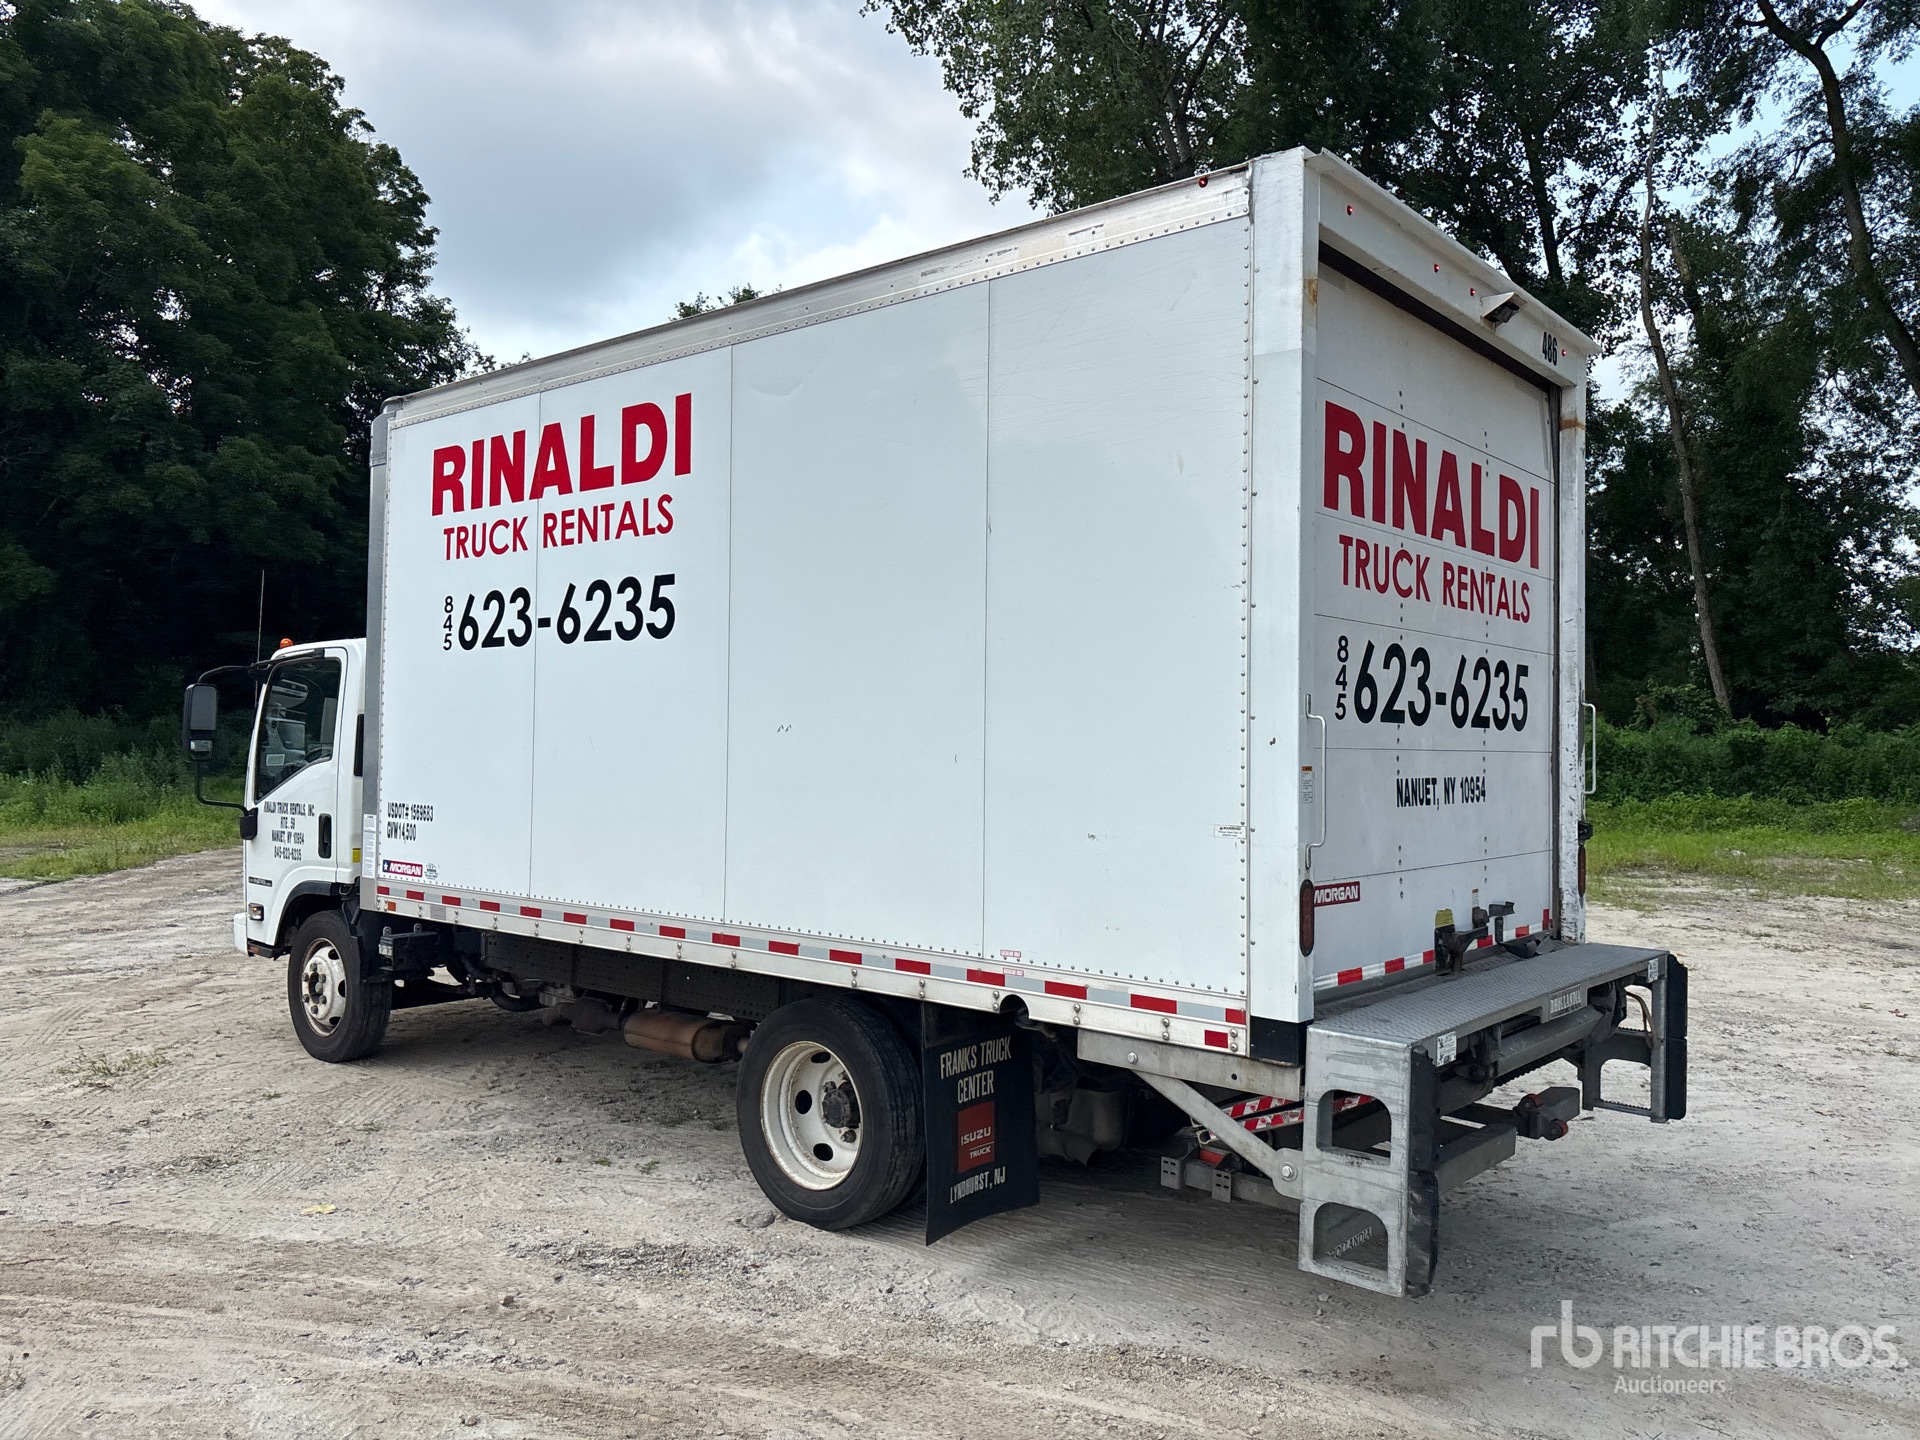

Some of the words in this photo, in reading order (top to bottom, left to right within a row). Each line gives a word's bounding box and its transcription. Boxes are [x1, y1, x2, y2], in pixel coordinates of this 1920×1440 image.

[1542, 331, 1557, 366] 486
[432, 392, 692, 516] RINALDI
[1323, 400, 1540, 570] RINALDI
[443, 516, 529, 561] TRUCK
[542, 494, 674, 548] RENTALS
[1338, 534, 1431, 602] TRUCK
[1443, 561, 1531, 624] RENTALS
[458, 573, 676, 651] 623-6235
[1354, 639, 1530, 732] 623-6235
[1396, 777, 1440, 811] NANUET,
[1444, 776, 1456, 805] NY
[1460, 776, 1486, 804] 10954
[389, 862, 422, 876] MORGAN
[1313, 885, 1359, 904] MORGAN
[940, 1044, 978, 1079] FRANKS
[980, 1036, 1011, 1066] TRUCK
[957, 1069, 994, 1104] CENTER
[960, 1126, 992, 1146] ISUZU
[969, 1146, 992, 1159] TRUCK
[993, 1166, 1006, 1185] NJ
